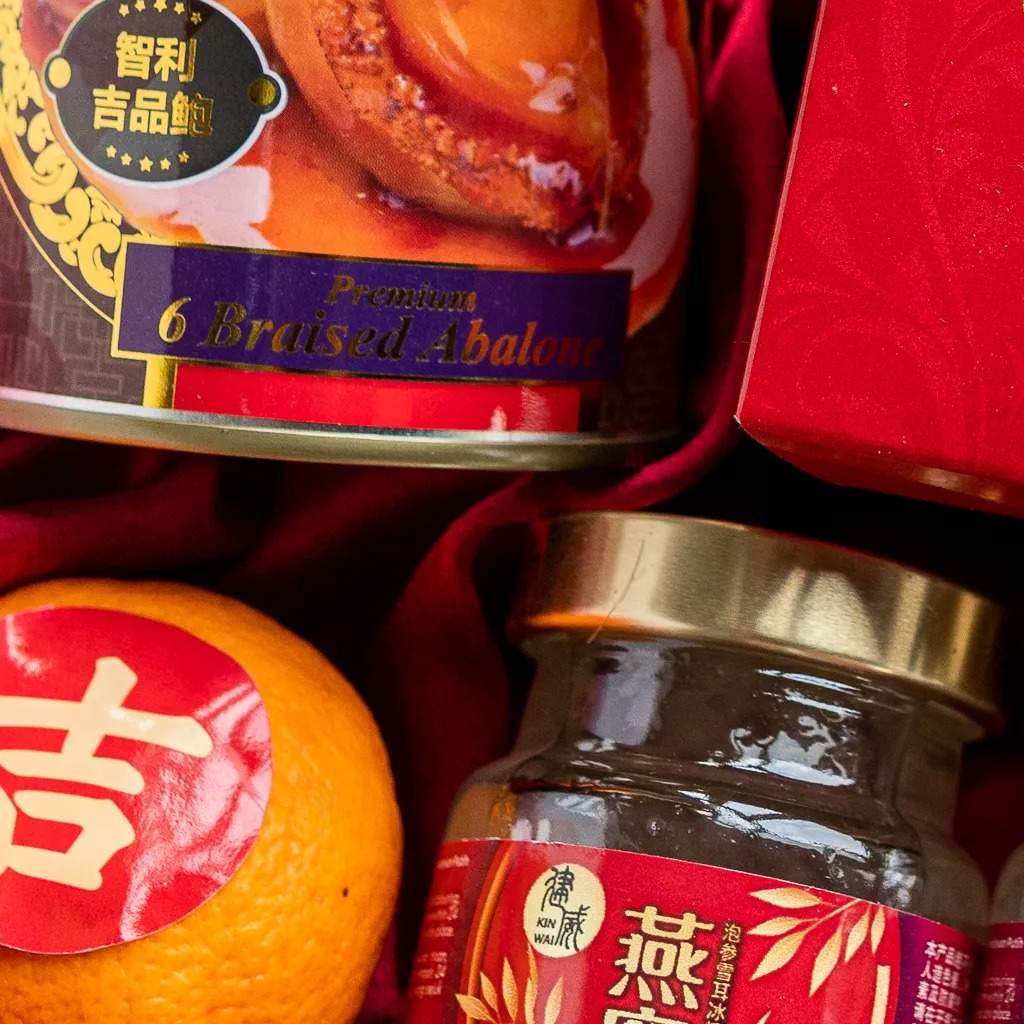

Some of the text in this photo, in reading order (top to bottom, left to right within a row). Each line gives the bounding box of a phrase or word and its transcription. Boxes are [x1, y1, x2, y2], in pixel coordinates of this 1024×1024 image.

[115, 31, 197, 82] 智利
[324, 275, 477, 311] Premium
[157, 296, 192, 344] 6
[202, 301, 413, 360] Braised
[0, 656, 213, 891] 吉
[533, 932, 555, 946] WAI
[536, 916, 557, 929] KIN
[607, 905, 715, 1024] 燕
